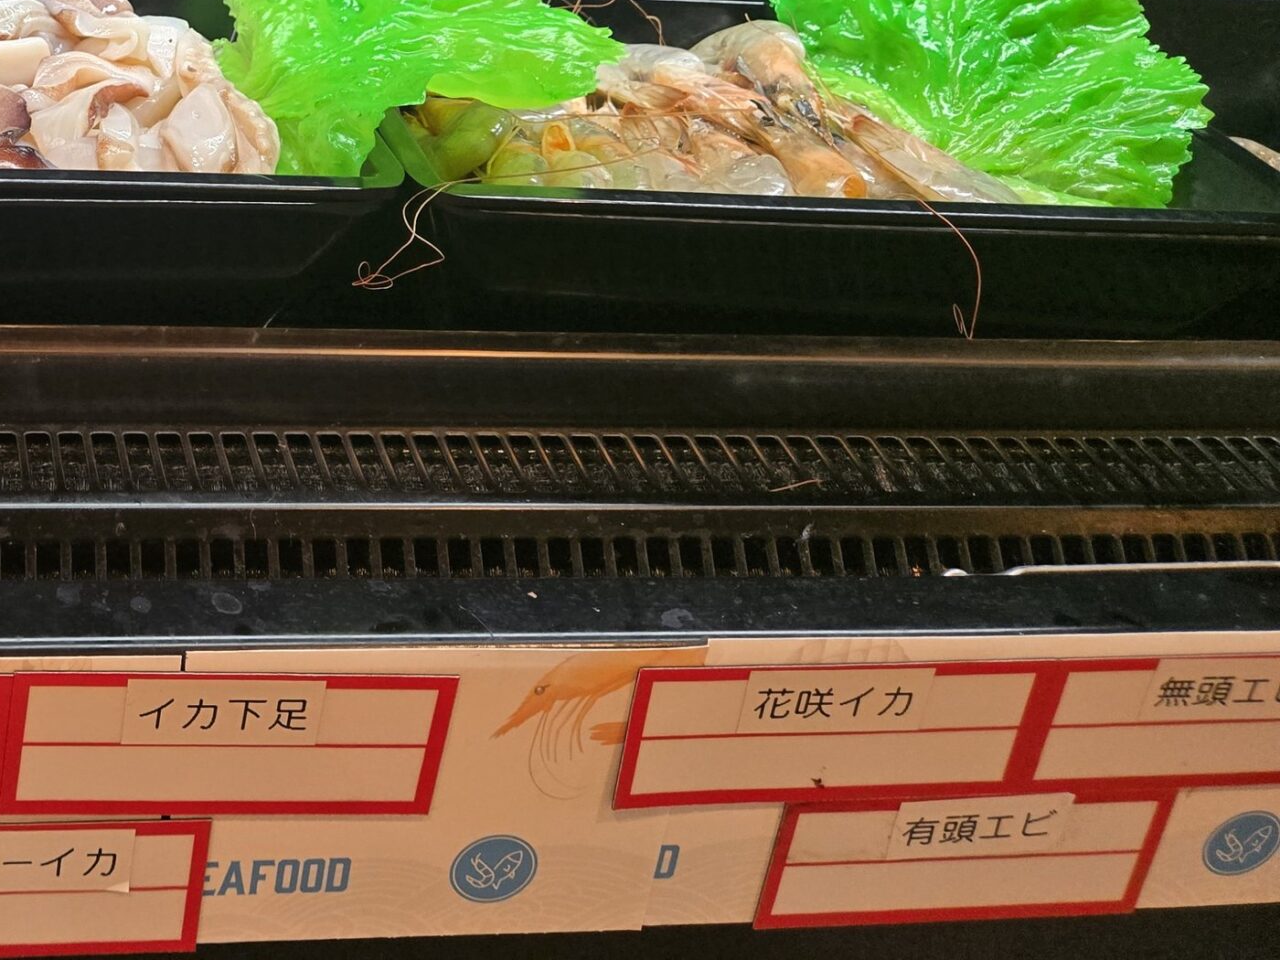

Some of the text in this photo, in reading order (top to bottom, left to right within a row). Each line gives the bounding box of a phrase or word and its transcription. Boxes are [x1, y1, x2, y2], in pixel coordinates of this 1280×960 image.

[754, 686, 914, 719] 花咲イカ
[1153, 676, 1280, 708] 無頭エ
[138, 696, 308, 732] イカ下足
[902, 809, 1058, 846] 有頭エビ
